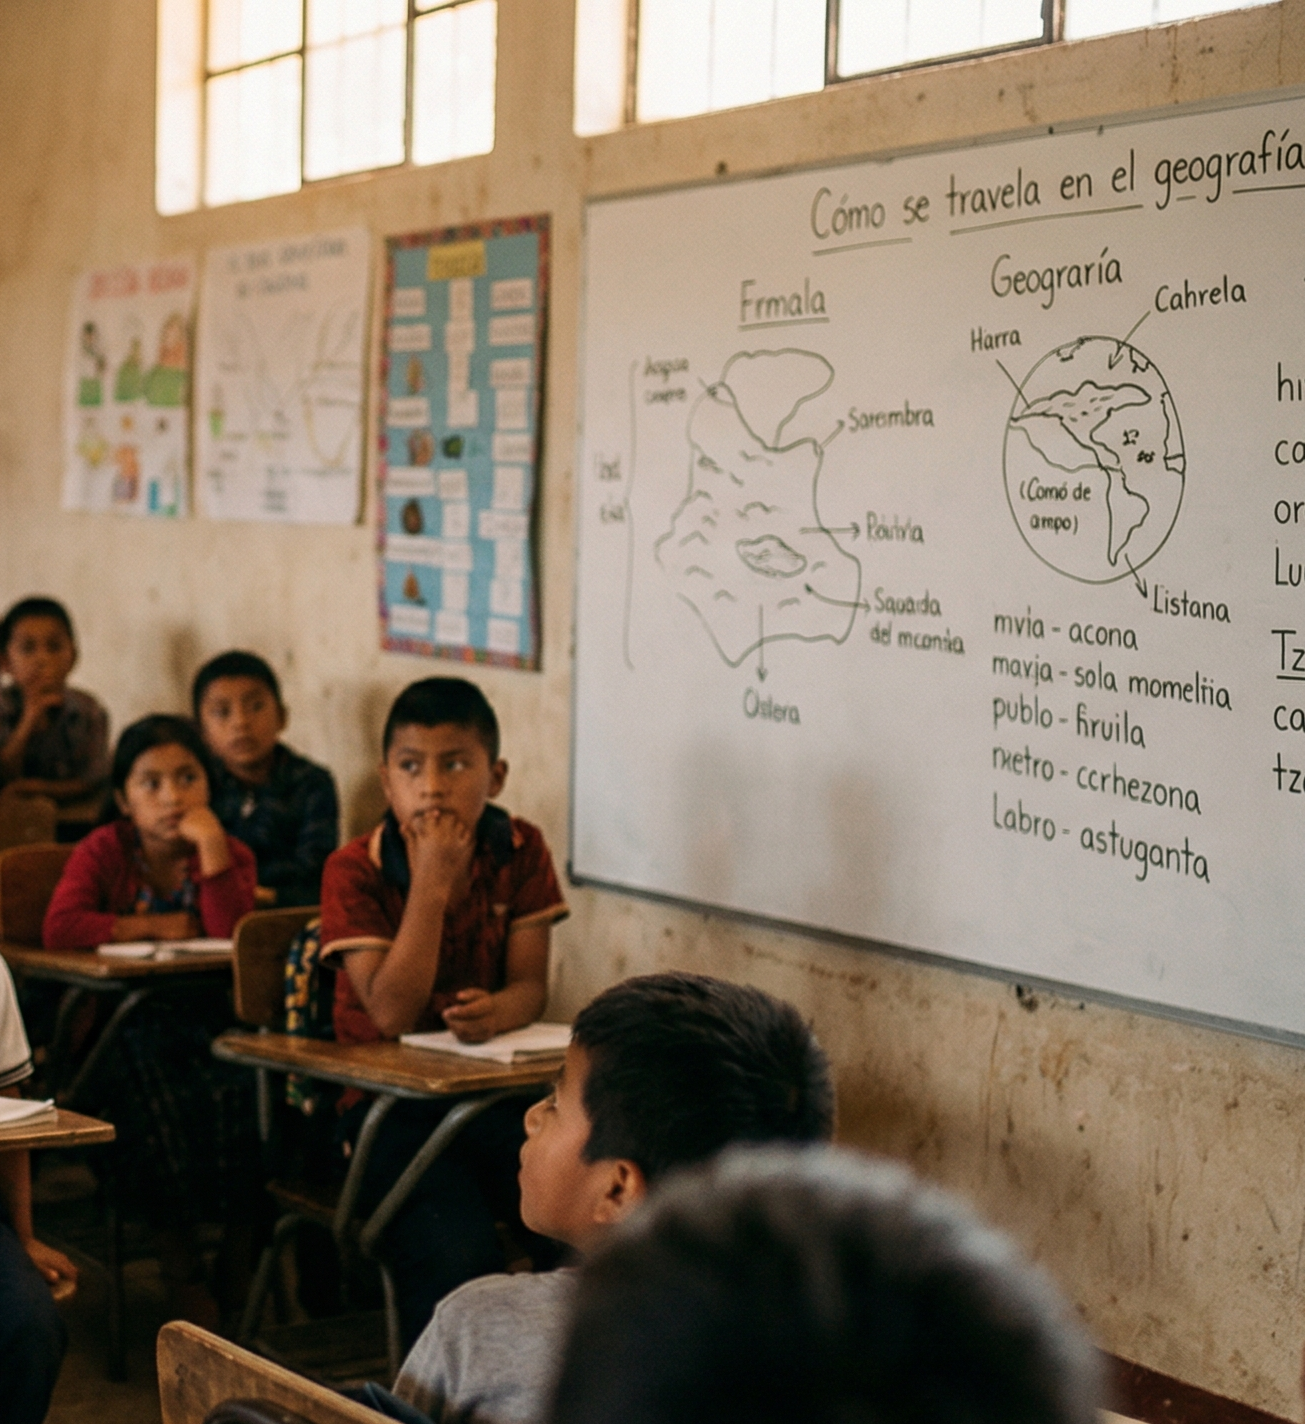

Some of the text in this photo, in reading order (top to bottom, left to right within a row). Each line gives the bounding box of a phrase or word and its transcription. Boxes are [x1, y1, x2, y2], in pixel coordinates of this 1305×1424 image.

[810, 128, 1305, 240] Cómo se travela en el geografía
[991, 246, 1122, 310] Geograría
[1154, 274, 1247, 313] Cahrela
[970, 326, 1022, 352] Harra
[1072, 482, 1092, 502] de
[1152, 584, 1232, 623] Listana
[1068, 621, 1139, 651] acona
[1074, 660, 1118, 693] sola
[992, 692, 1054, 730] publo
[1080, 819, 1211, 884] astuganta
